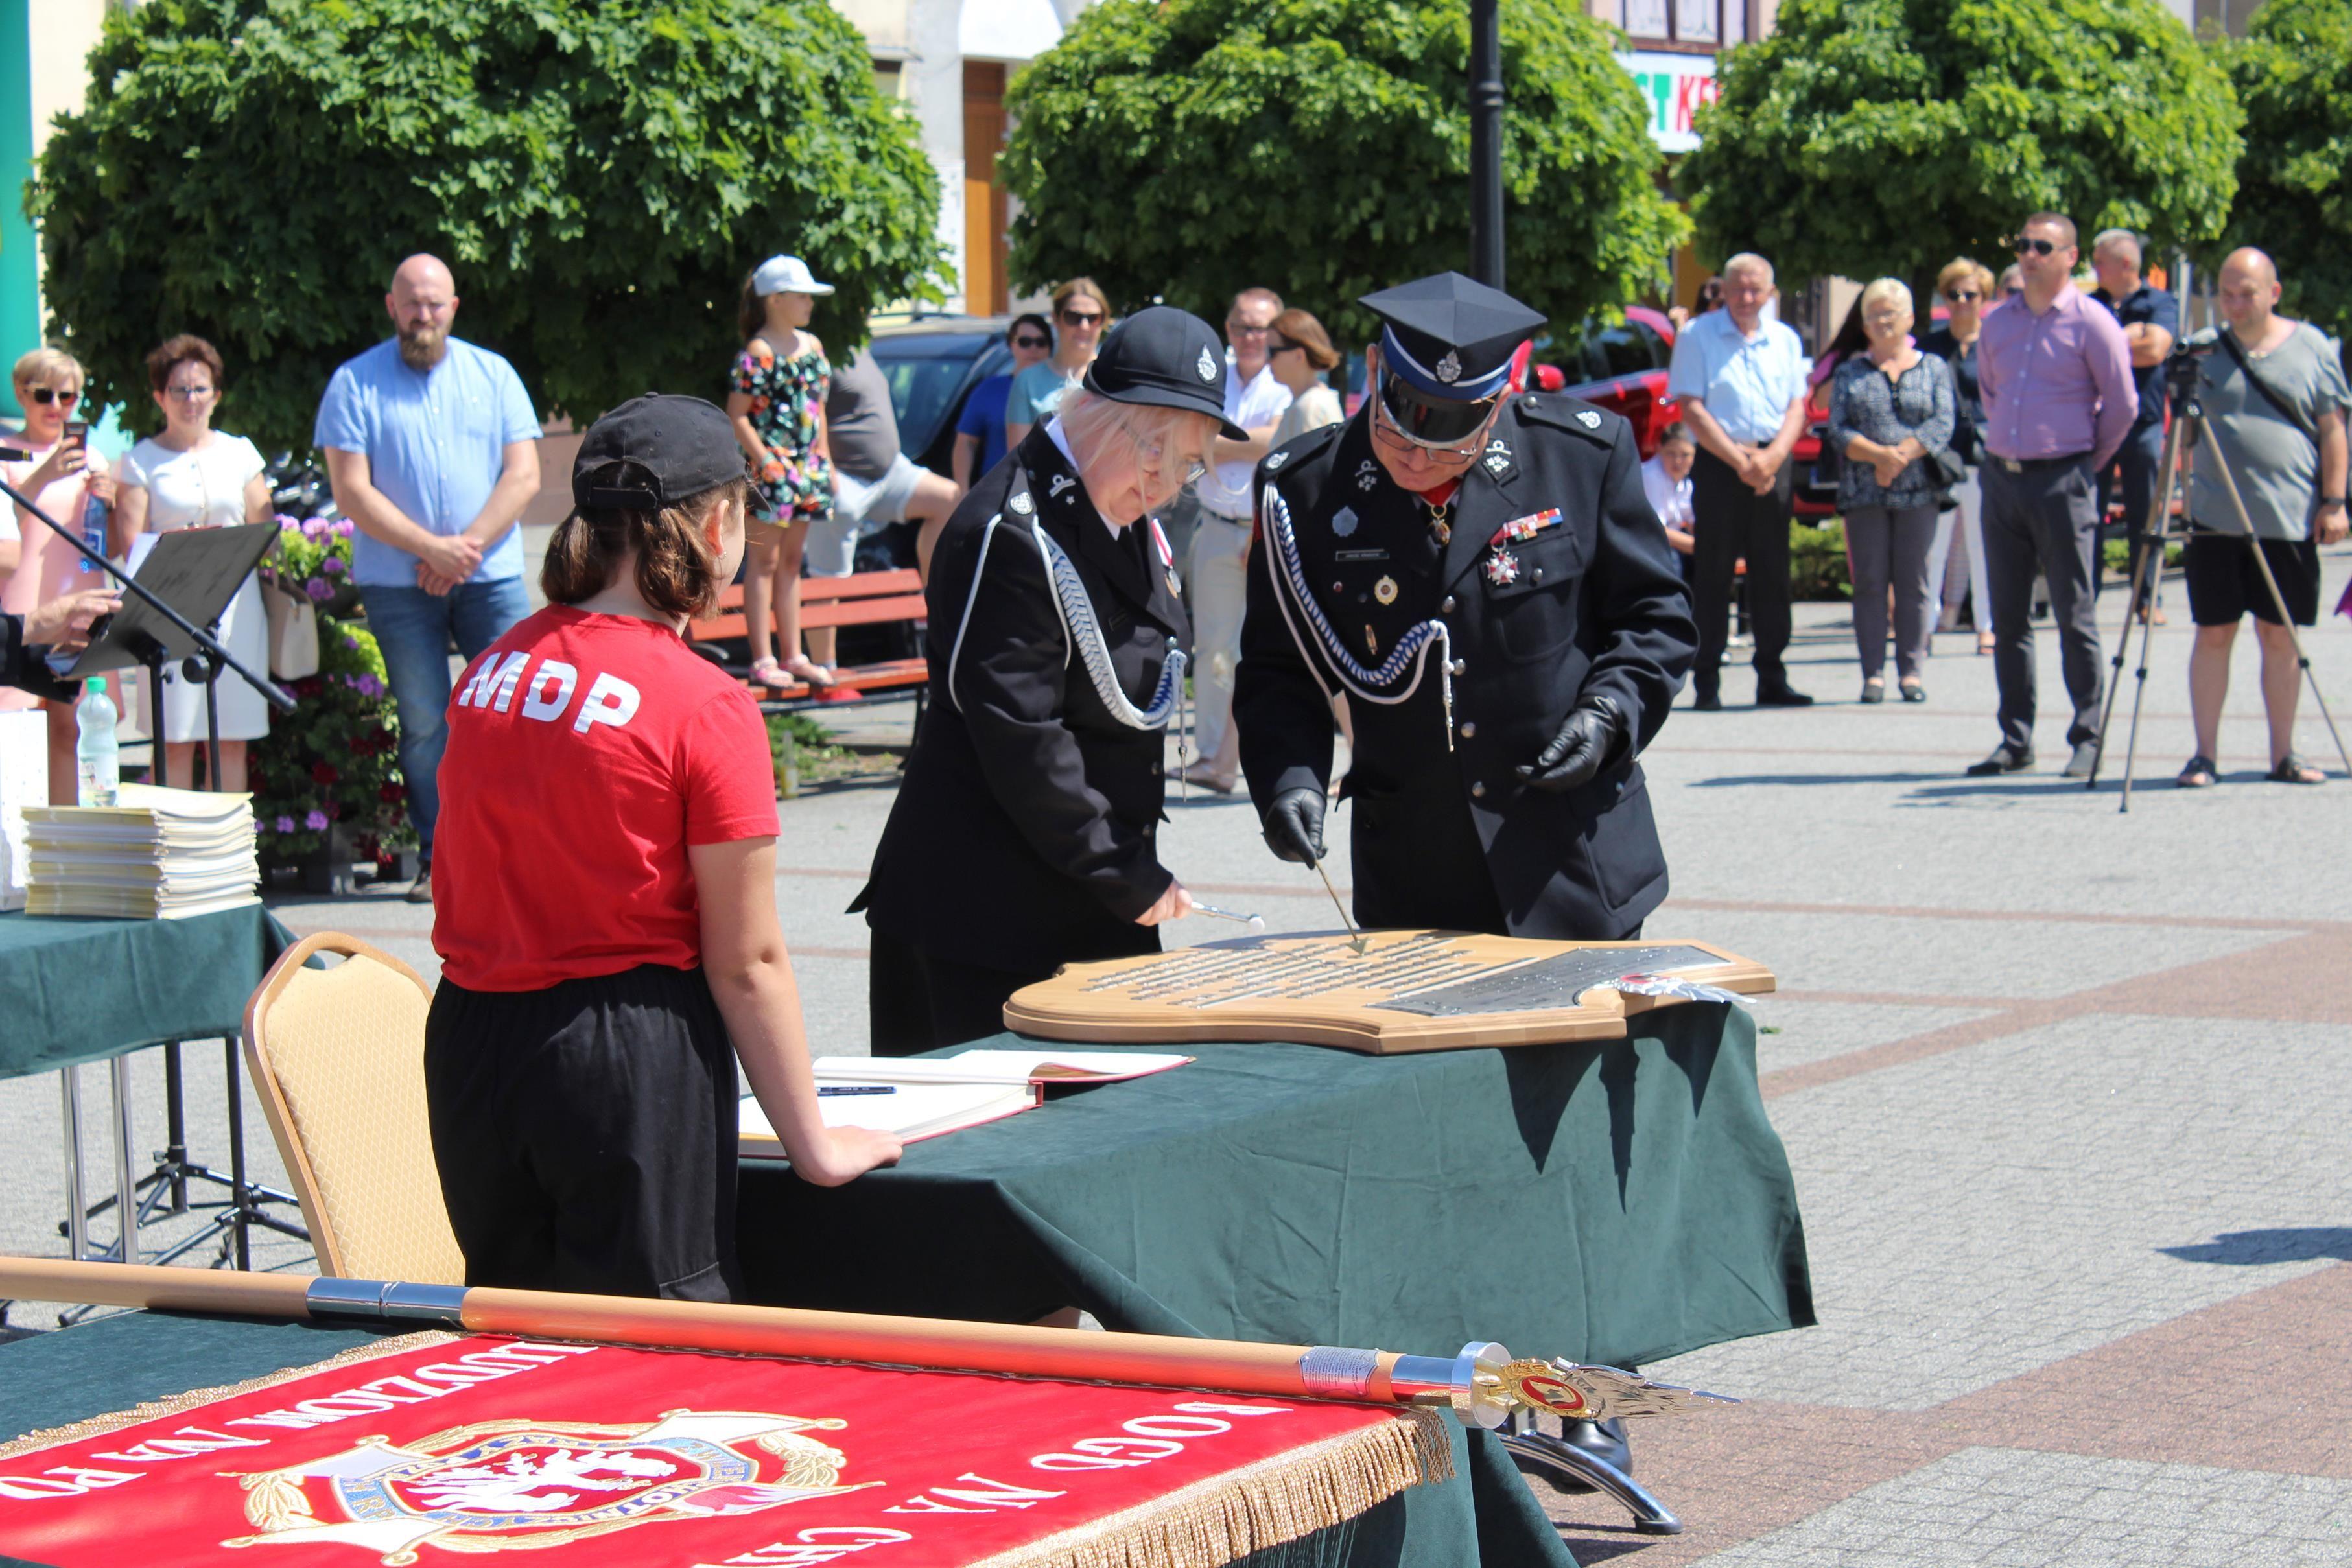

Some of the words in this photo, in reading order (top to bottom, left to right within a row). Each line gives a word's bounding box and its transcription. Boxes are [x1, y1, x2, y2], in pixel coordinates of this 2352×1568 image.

[458, 650, 641, 734] MDP
[225, 1341, 598, 1429] LUDZIOM
[89, 1426, 271, 1462] NA
[1030, 1401, 1294, 1471] BOGU
[882, 1472, 1068, 1513] NA
[691, 1526, 913, 1568] CH
